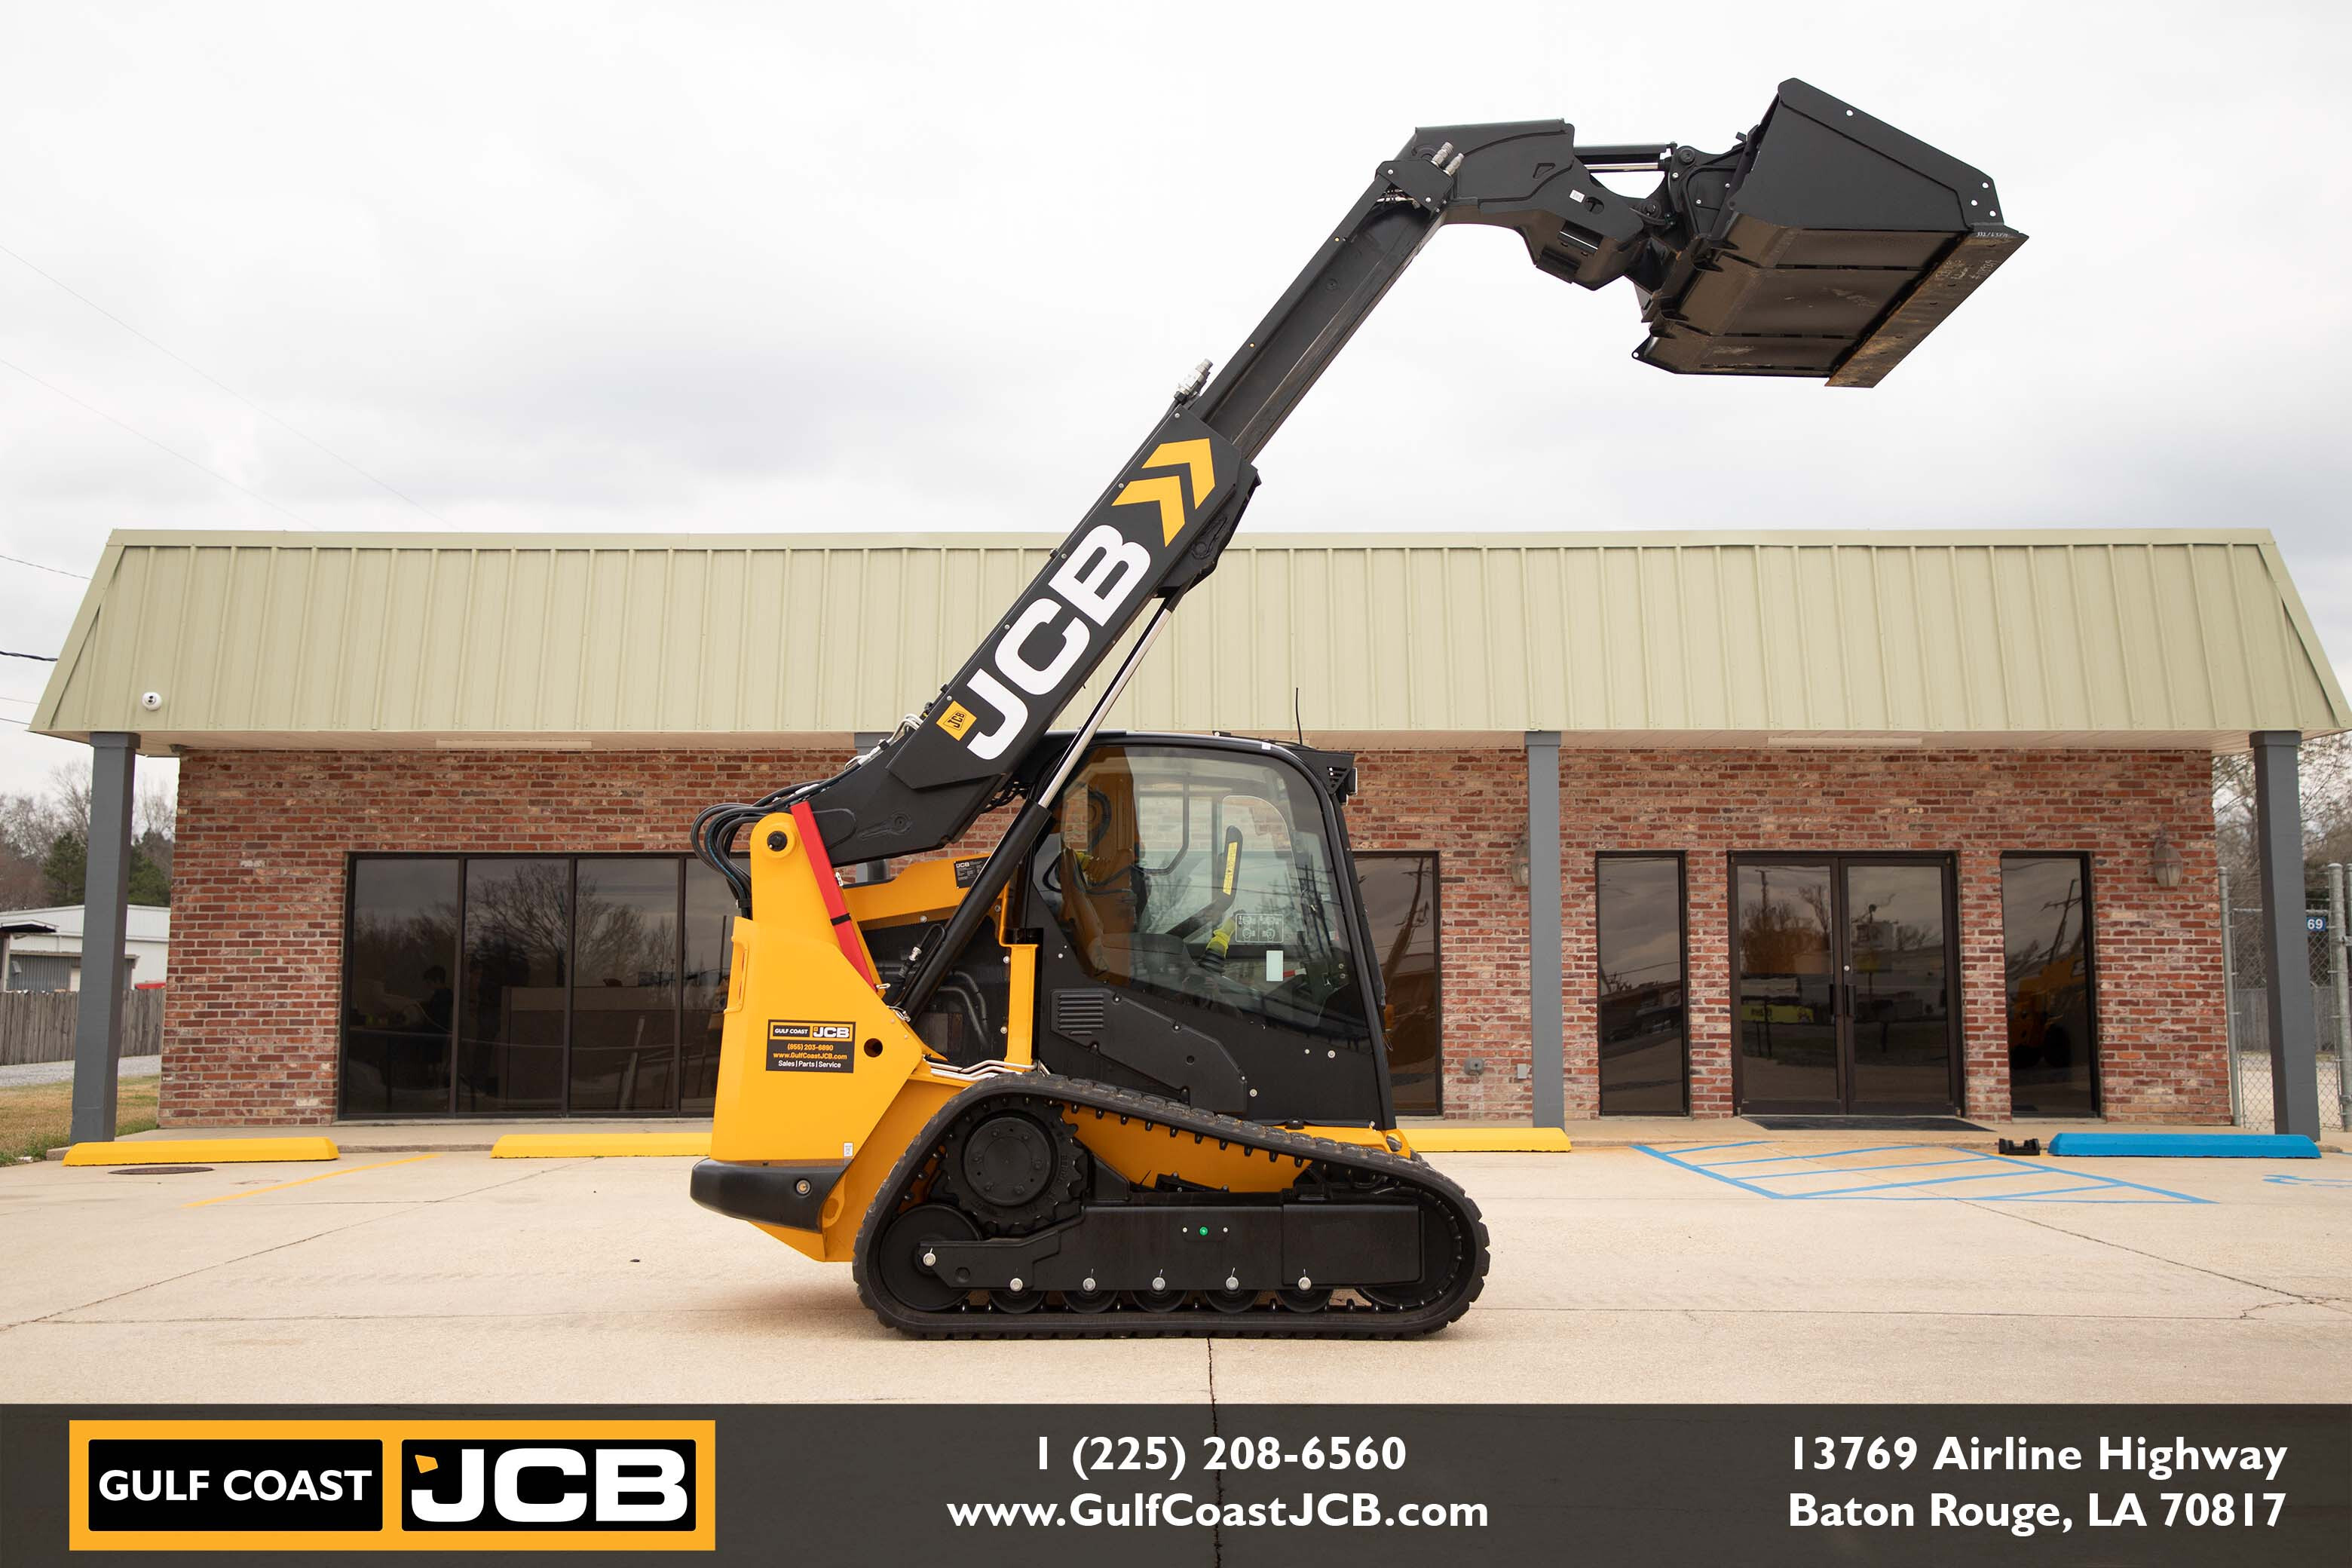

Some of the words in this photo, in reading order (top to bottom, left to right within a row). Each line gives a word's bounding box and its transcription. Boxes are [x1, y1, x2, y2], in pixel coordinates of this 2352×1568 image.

[966, 524, 1152, 761] JCB
[947, 712, 965, 728] JCB
[813, 1026, 850, 1038] JCB
[773, 1052, 848, 1060] www.GulfCoastJCB.com
